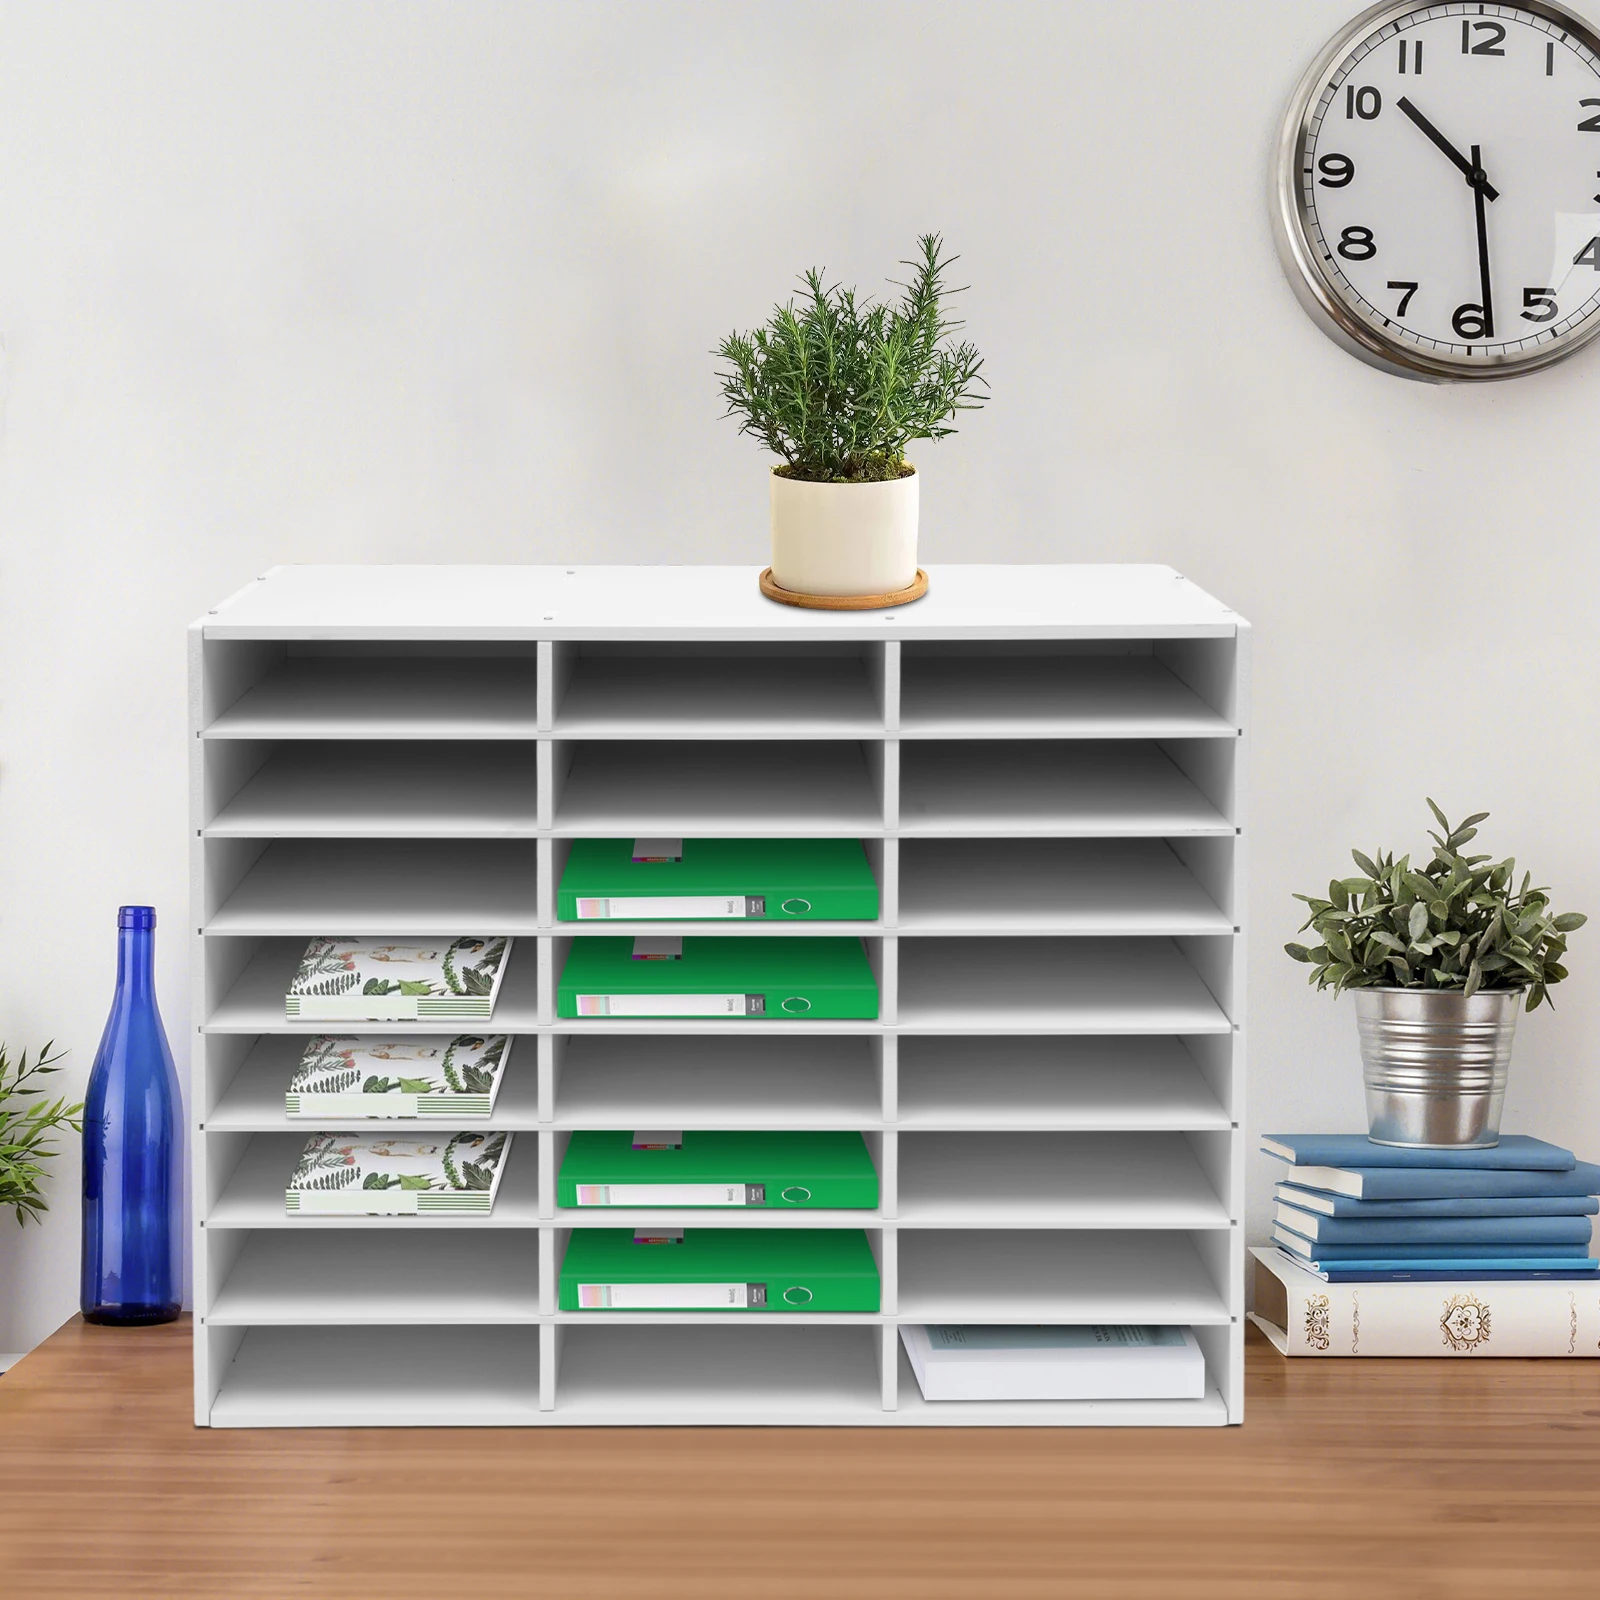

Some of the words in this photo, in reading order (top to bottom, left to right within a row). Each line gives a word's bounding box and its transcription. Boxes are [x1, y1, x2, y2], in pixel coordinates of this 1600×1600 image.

[1461, 19, 1507, 57] 12
[1398, 39, 1423, 75] 11
[1545, 42, 1554, 77] 1
[1346, 84, 1382, 121] 10
[1577, 97, 1600, 133] 2
[1317, 152, 1355, 189] 9
[1336, 225, 1377, 262] 8
[1573, 236, 1600, 272] 4
[1386, 280, 1419, 318] 7
[1519, 287, 1559, 323] 5
[1451, 303, 1488, 340] 6
